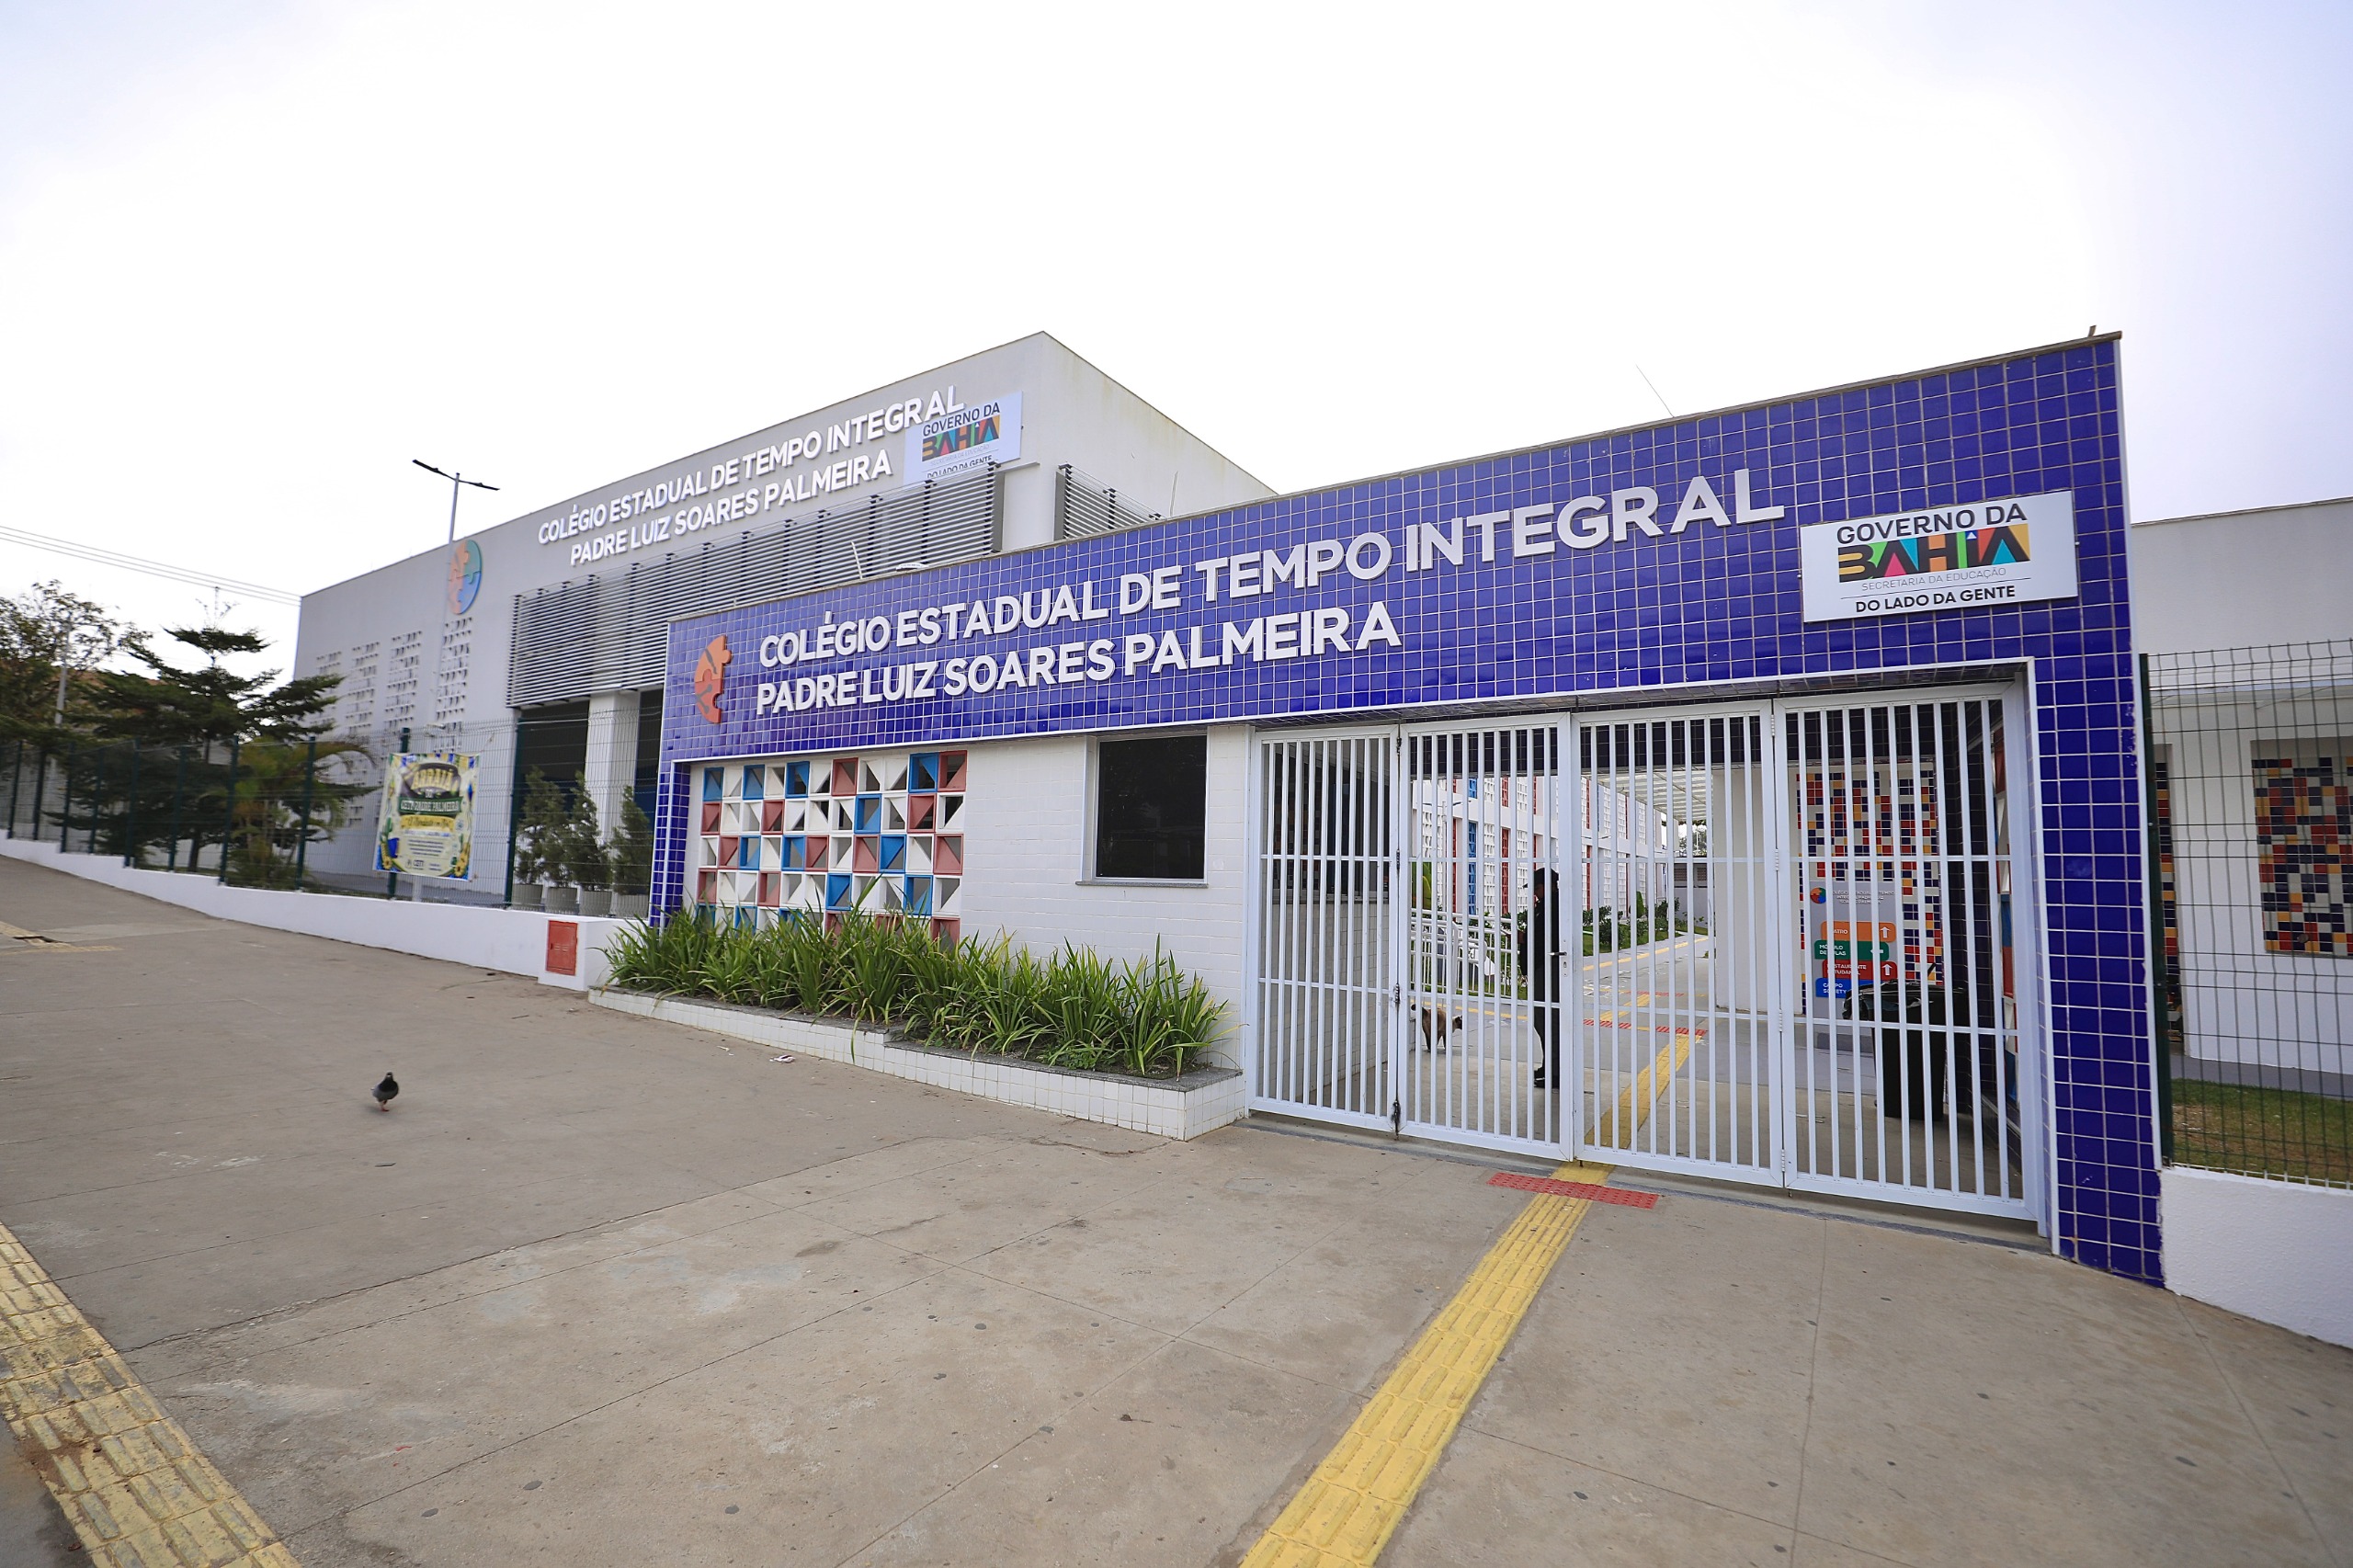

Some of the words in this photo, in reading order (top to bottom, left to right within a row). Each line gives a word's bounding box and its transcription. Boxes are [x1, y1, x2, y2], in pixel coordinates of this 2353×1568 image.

[921, 415, 1000, 461] BAHIA
[923, 407, 980, 437] GOVERNO
[983, 402, 1000, 417] DA
[539, 504, 608, 544] COLÉGIO
[609, 471, 709, 523] ESTADUAL
[710, 458, 740, 490] DE
[743, 430, 824, 480] TEMPO
[827, 385, 966, 453] INTEGRAL
[570, 528, 629, 566] PADRE
[631, 515, 673, 550] LUIZ
[674, 487, 760, 536] SOARES
[764, 449, 893, 511] PALMEIRA
[1837, 509, 1975, 545] GOVERNO
[1985, 503, 2028, 526] DA
[759, 611, 891, 668] COLÉGIO
[896, 581, 1108, 647] ESTADUAL
[1120, 565, 1182, 615] DE
[1195, 532, 1392, 603] TEMPO
[1405, 469, 1786, 573] INTEGRAL
[1837, 523, 2031, 583] BAHIA
[1861, 575, 1926, 592] SECRETARIA
[1928, 574, 1944, 585] DA
[1946, 567, 2006, 583] EDUCAÇÃO
[1855, 599, 1881, 613] DO
[1884, 594, 1929, 610] LADO
[1933, 592, 1957, 605] DA
[1960, 585, 2016, 602] GENTE
[756, 678, 858, 715] PADRE
[862, 661, 938, 702] LUIZ
[943, 639, 1115, 696] SOARES
[1125, 601, 1403, 676] PALMEIRA
